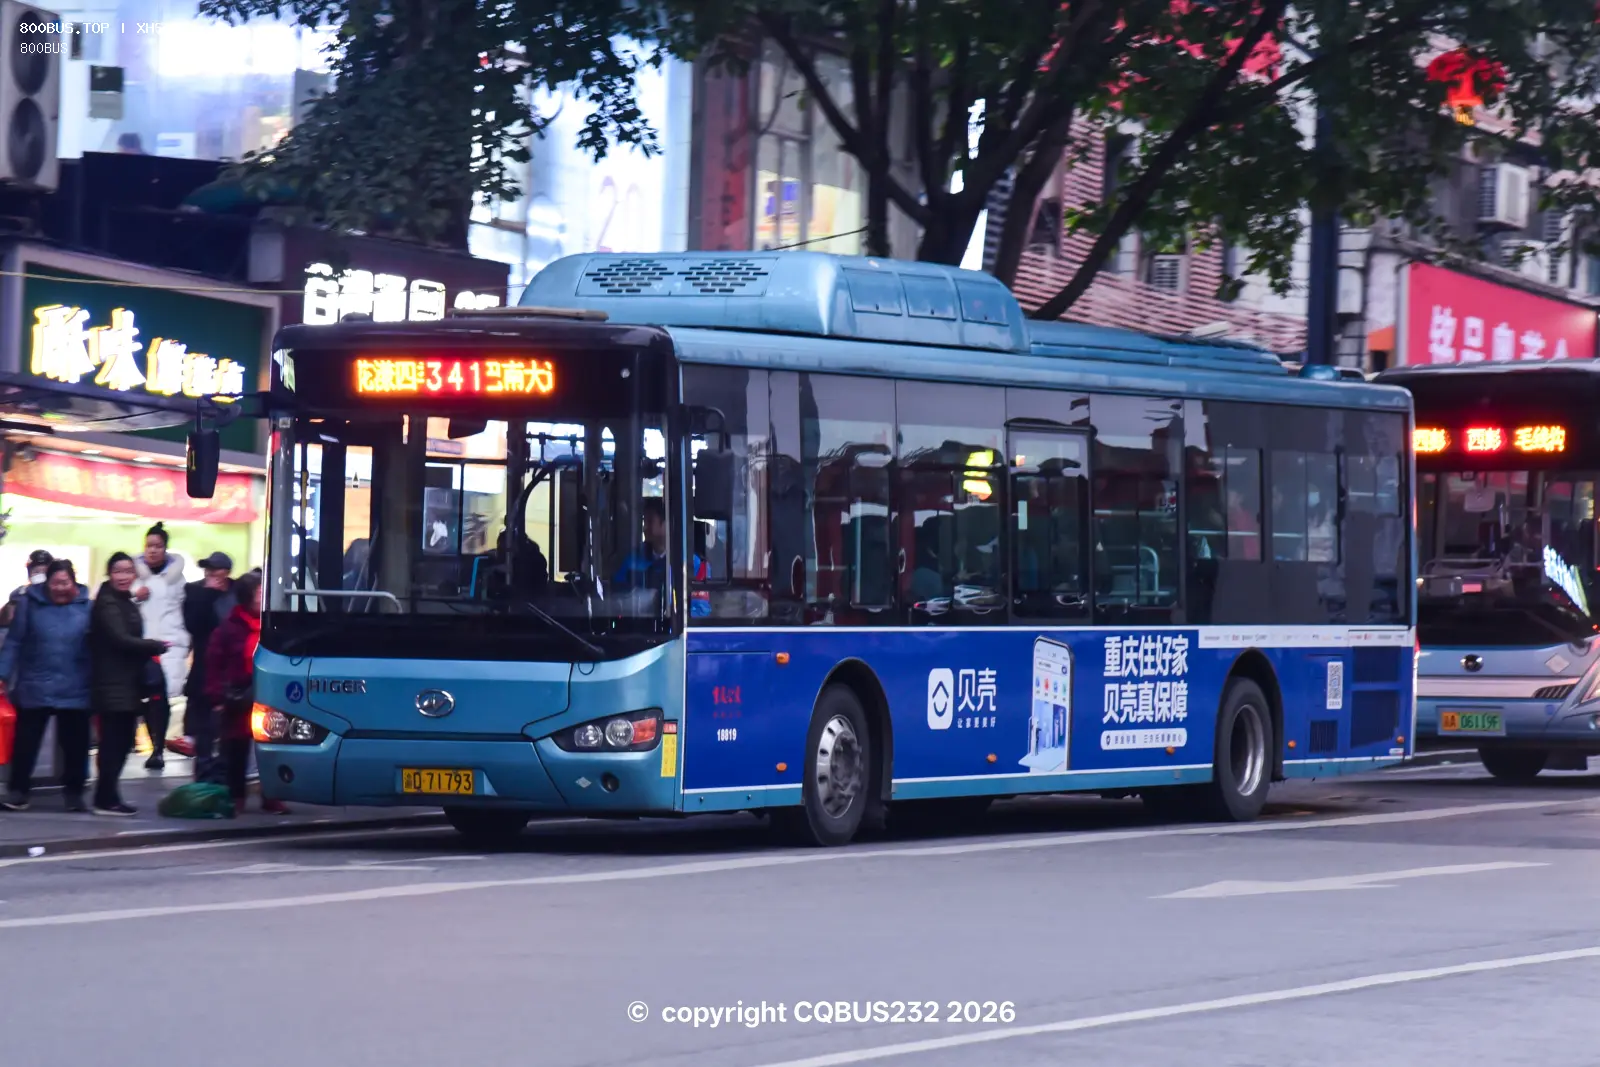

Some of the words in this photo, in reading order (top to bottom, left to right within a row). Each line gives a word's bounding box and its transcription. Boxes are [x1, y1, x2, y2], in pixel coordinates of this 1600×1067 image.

[425, 361, 480, 391] 341
[486, 359, 554, 393] 巴南大
[1103, 634, 1189, 677] 重庆住好家
[309, 679, 367, 694] HIGER
[957, 667, 997, 712] 贝壳
[1102, 680, 1189, 724] 贝壳真保障
[717, 728, 737, 742] 18819
